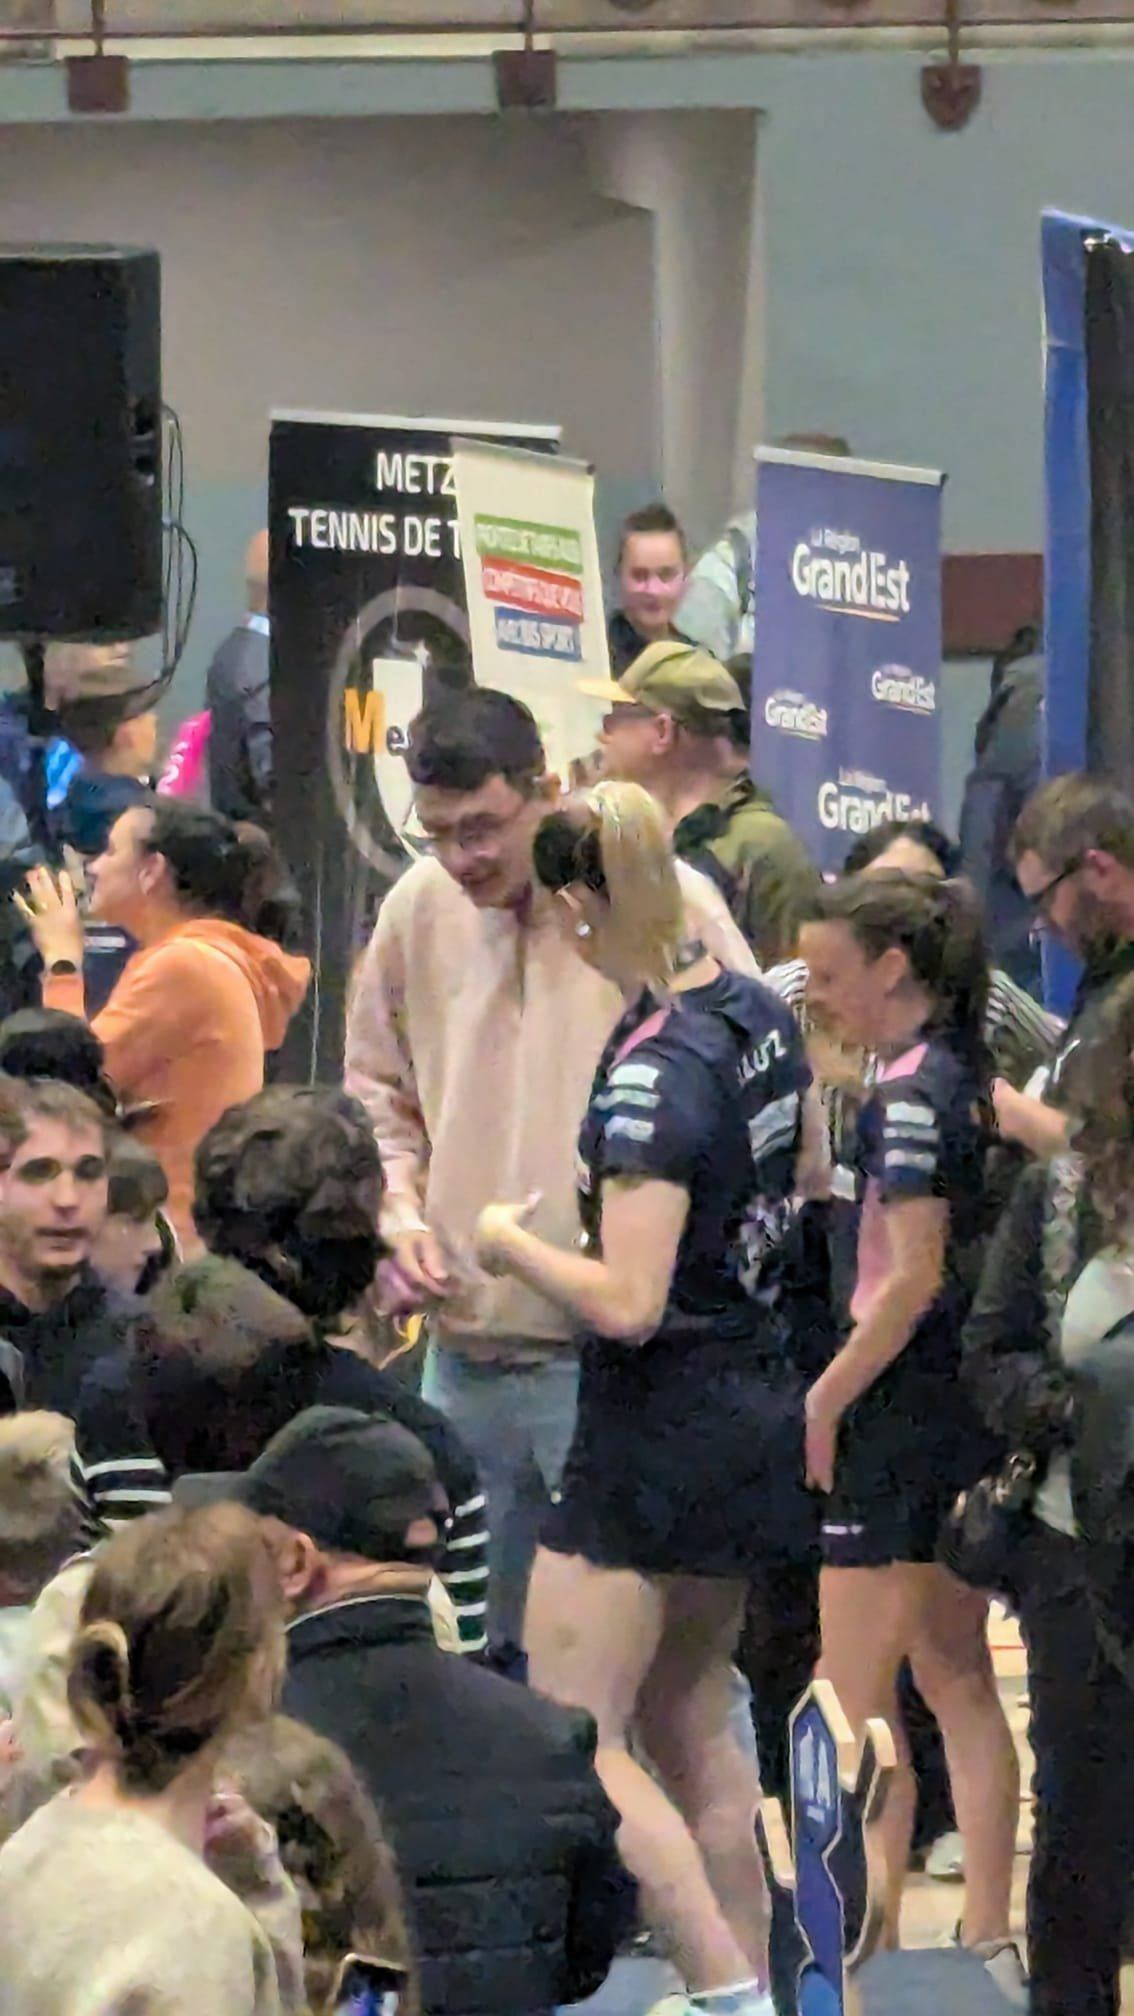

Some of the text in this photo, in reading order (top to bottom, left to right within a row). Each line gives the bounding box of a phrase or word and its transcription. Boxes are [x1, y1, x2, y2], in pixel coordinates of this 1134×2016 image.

[376, 450, 457, 495] METZ
[288, 507, 396, 555] TENNIS
[403, 515, 442, 558] DE
[344, 686, 411, 756] Me
